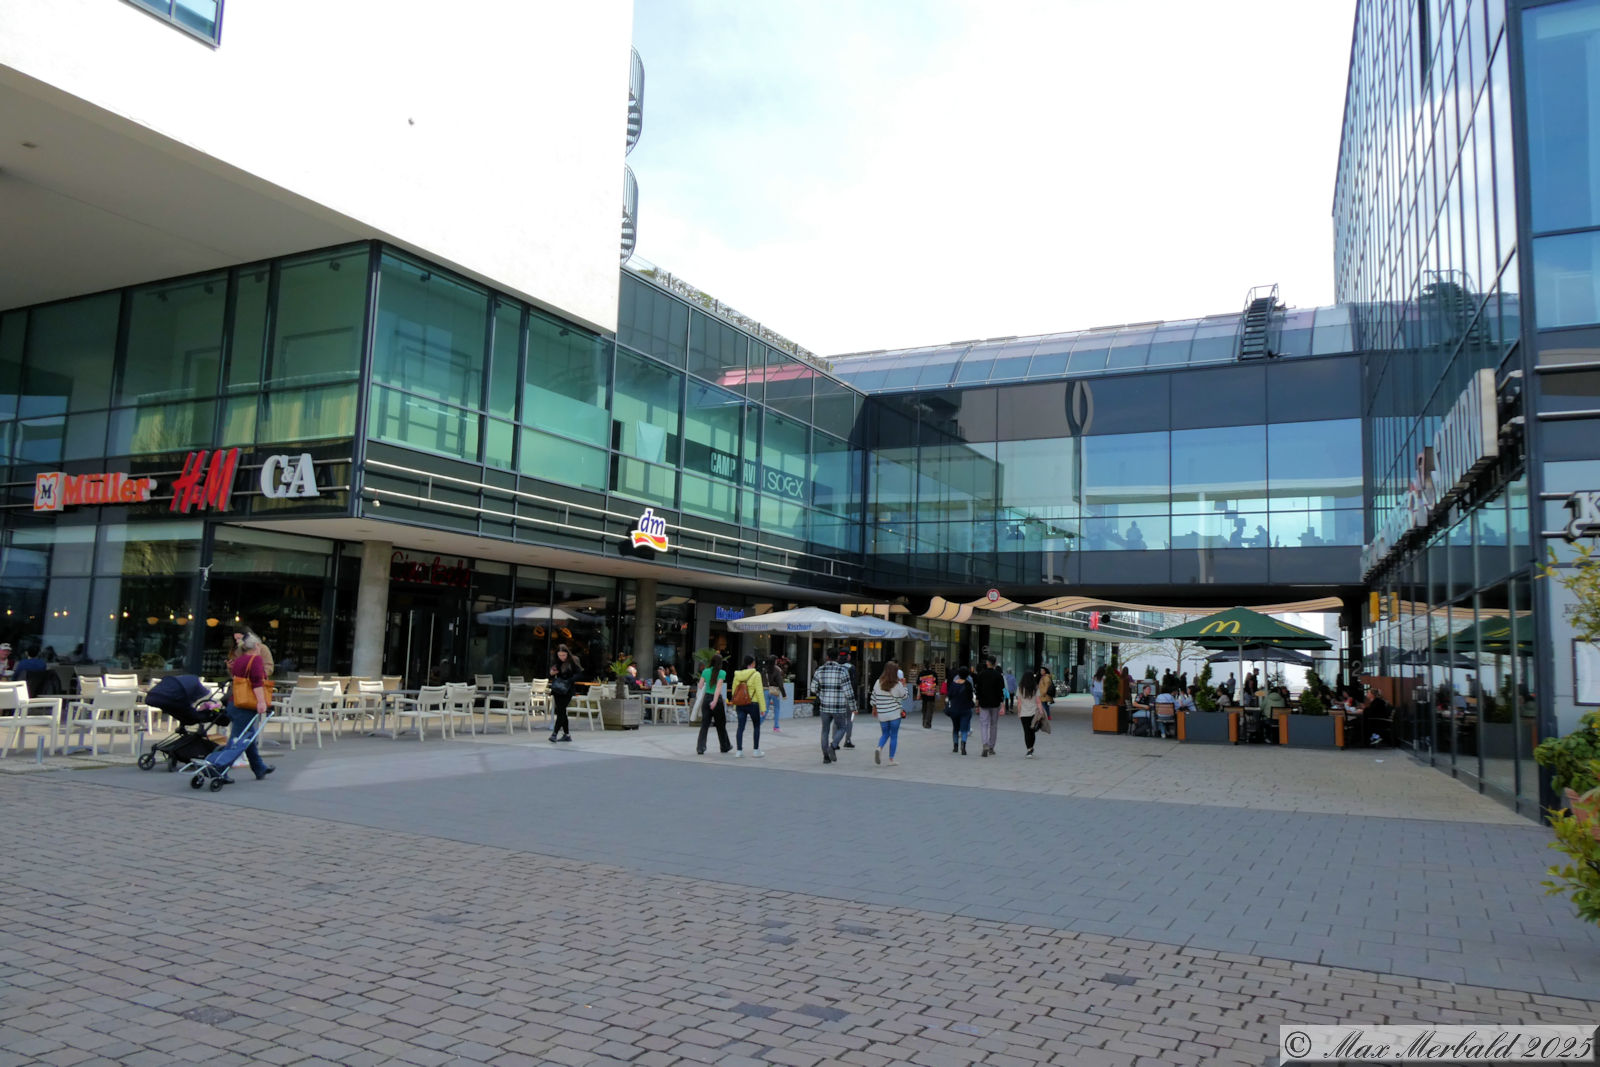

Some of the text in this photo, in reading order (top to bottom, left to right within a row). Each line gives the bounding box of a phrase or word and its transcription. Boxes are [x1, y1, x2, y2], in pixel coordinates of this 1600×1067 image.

[62, 472, 151, 505] Müller
[169, 447, 239, 514] H&M
[260, 453, 320, 498] C&A
[710, 452, 736, 478] CAMP
[767, 471, 804, 499] SOCCX
[640, 510, 664, 535] dm
[1351, 660, 1362, 677] 2
